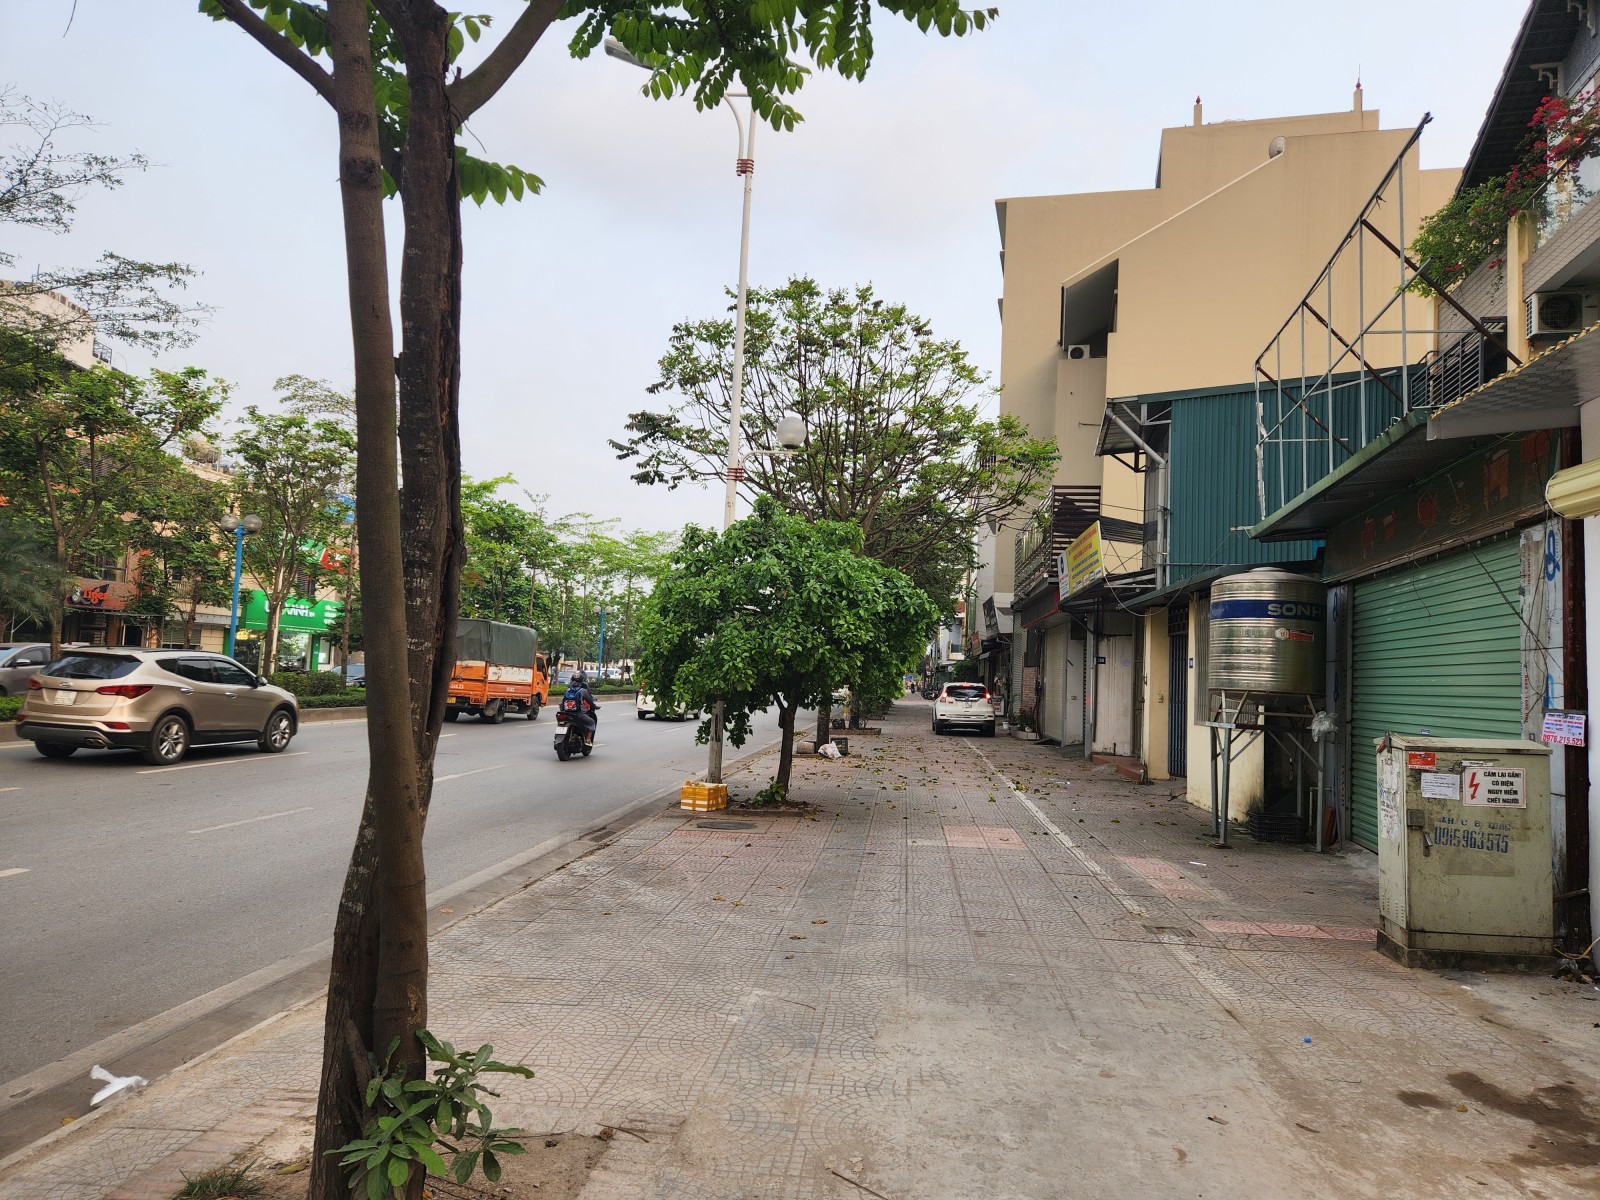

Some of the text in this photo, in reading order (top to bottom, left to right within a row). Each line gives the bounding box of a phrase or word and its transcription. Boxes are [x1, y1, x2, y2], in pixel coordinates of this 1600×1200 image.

[82, 588, 107, 604] Tiger
[1267, 603, 1326, 618] SONH
[1542, 734, 1583, 746] 0976.215.523
